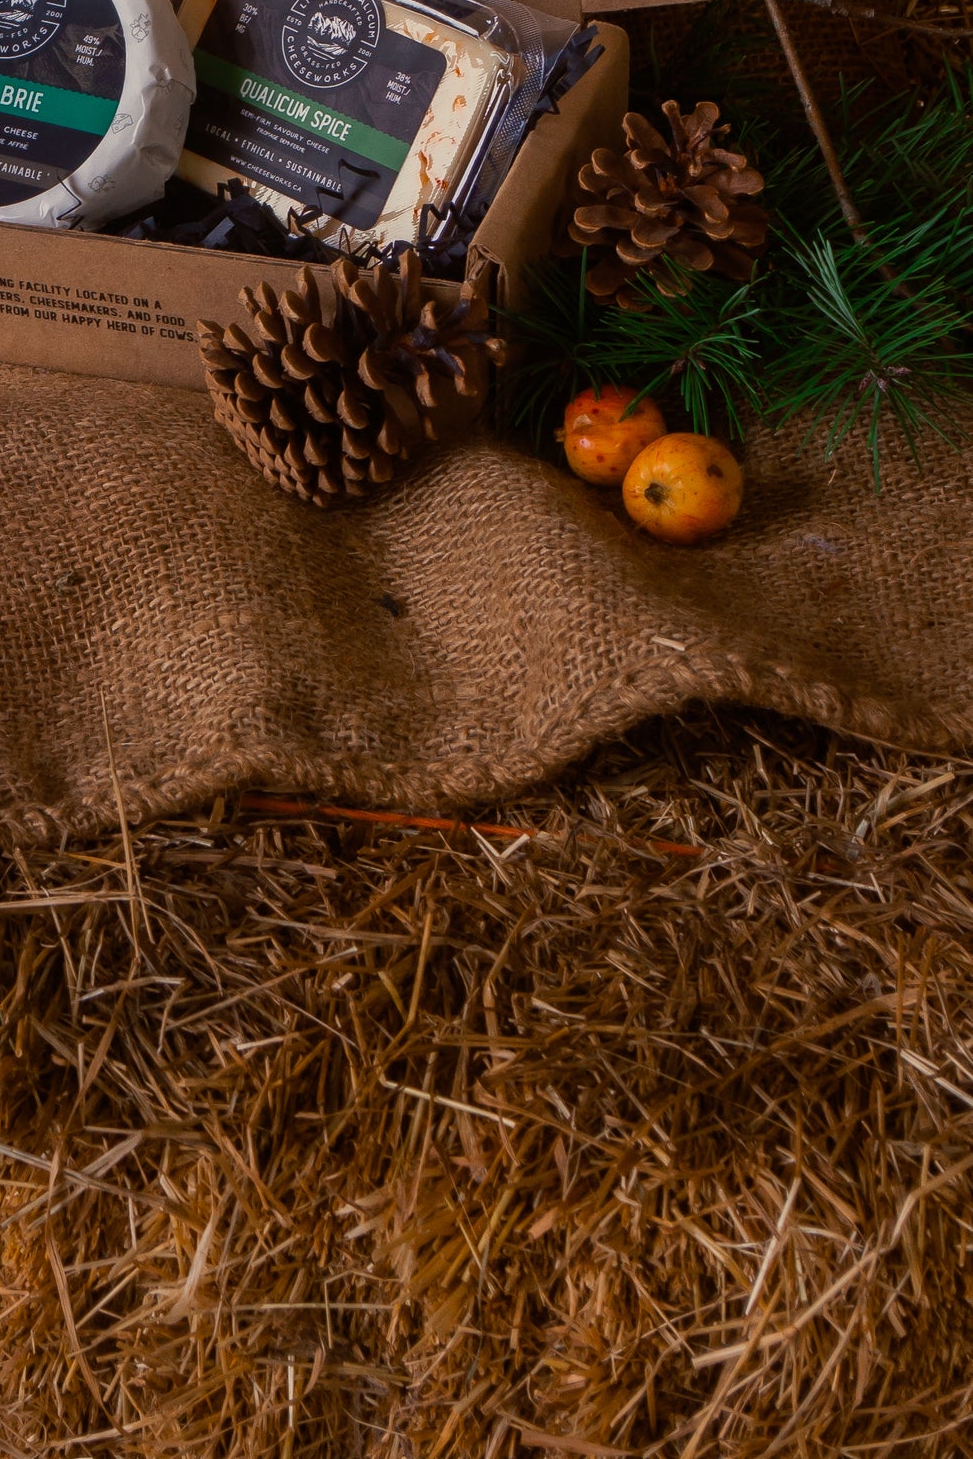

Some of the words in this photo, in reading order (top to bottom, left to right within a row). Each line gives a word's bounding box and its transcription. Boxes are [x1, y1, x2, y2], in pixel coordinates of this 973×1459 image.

[46, 10, 63, 20] 2001
[243, 2, 258, 16] 30%
[318, 0, 363, 26] HANDCRAFTED
[83, 34, 100, 46] 49%
[286, 15, 302, 27] ESTD
[357, 47, 372, 58] 2001
[286, 36, 357, 83] CHEESEWORKS
[300, 45, 342, 70] GRASS-FED
[395, 71, 411, 84] 38%
[0, 85, 44, 113] BRIE
[240, 78, 311, 123] QUALICUM
[310, 110, 353, 142] SPICE
[4, 126, 39, 141] CHEESE
[240, 108, 271, 128] SEMI-FIRM
[273, 123, 304, 141] SAVOURY
[306, 139, 330, 155] CHEESE
[256, 127, 280, 145] FROMAGE
[205, 123, 231, 142] LOCAL
[241, 139, 275, 162] ETHICAL
[285, 160, 343, 192] SUSTAINABLE
[230, 155, 303, 193] WWW.CHEESEWORKS.CA
[19, 280, 71, 297] FACILITY
[76, 288, 128, 306] LOCATED
[133, 298, 149, 309] ON
[154, 300, 162, 310] A
[0, 304, 29, 317] FROM
[34, 309, 58, 323] OUR
[62, 313, 103, 329] HAPPY
[106, 320, 137, 334] HERD
[141, 325, 156, 337] OF
[160, 328, 199, 343] COWS.
[127, 309, 151, 323] AND
[156, 314, 185, 328] FOOD
